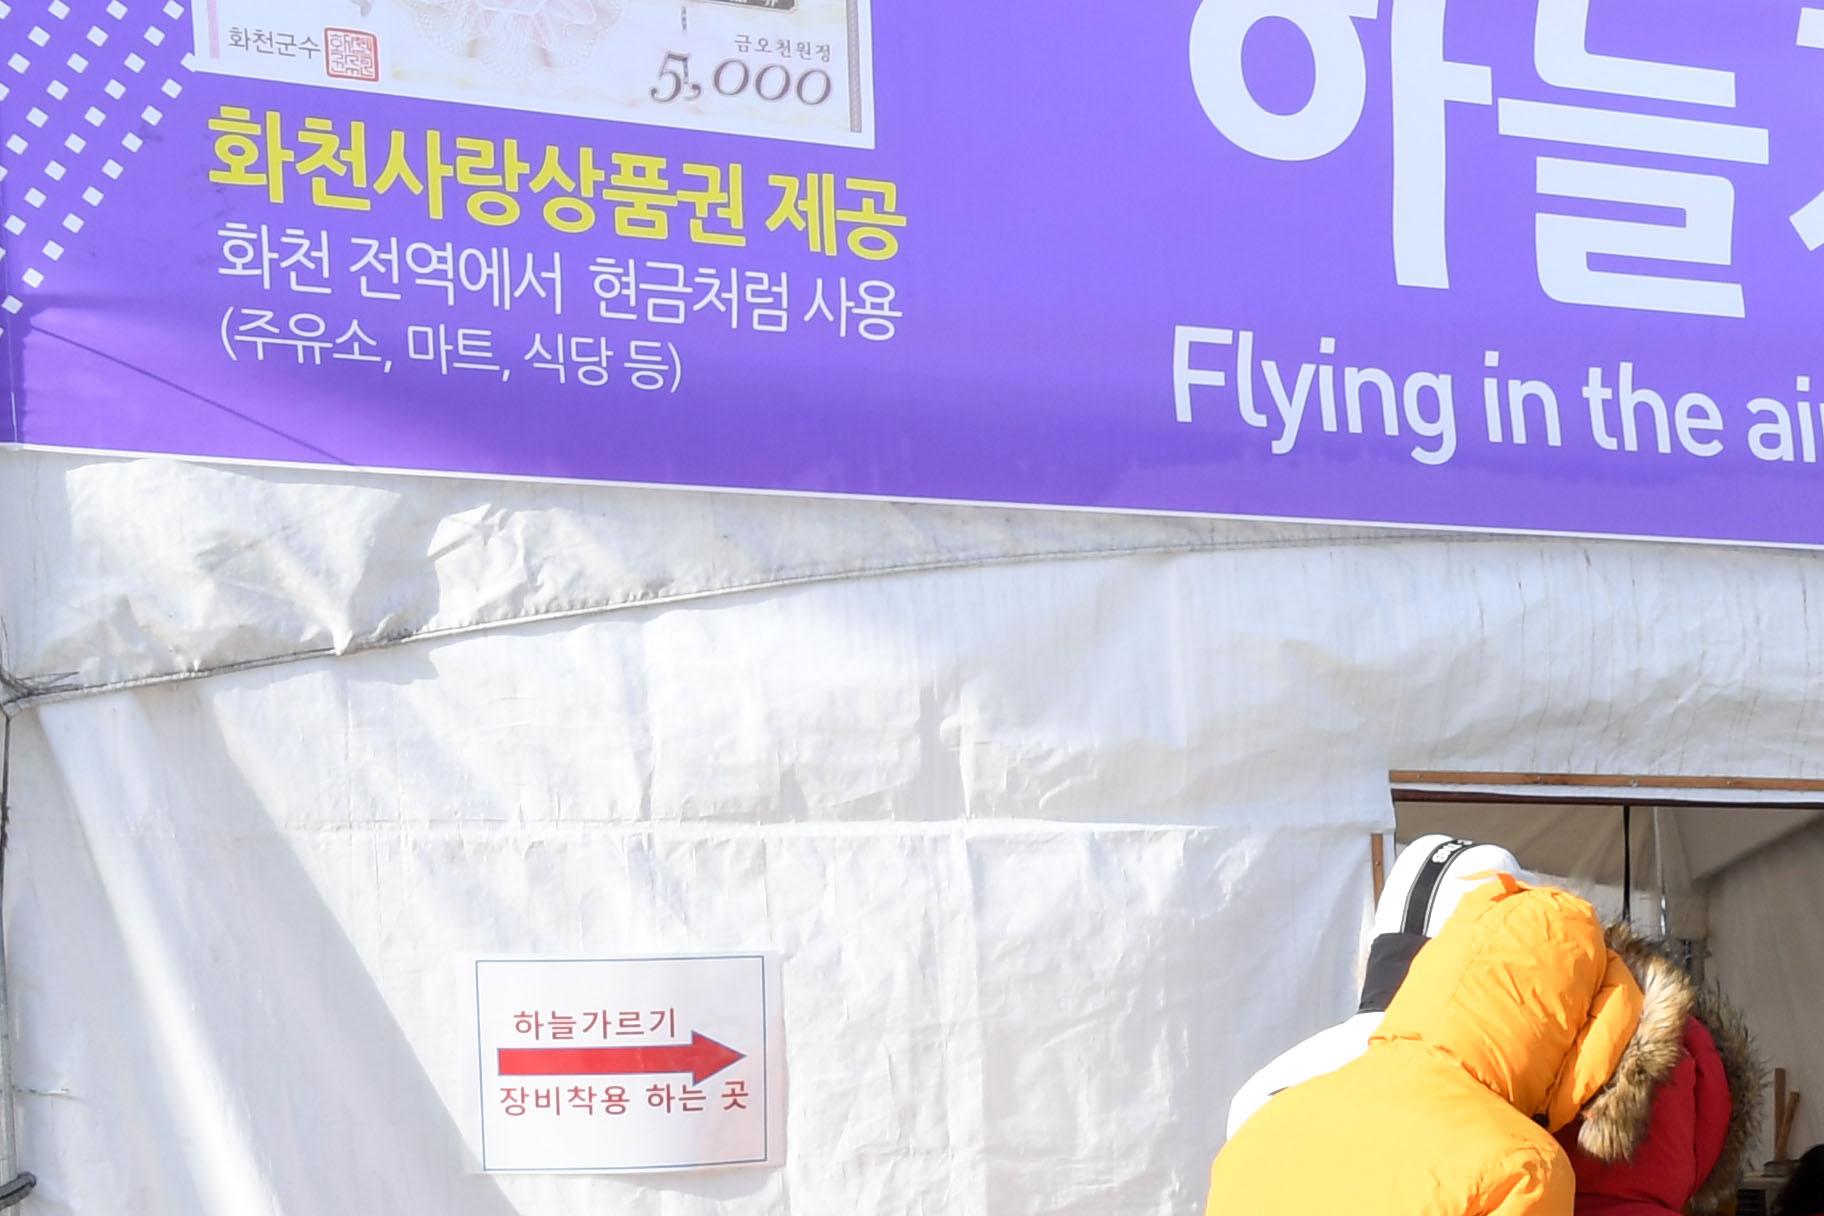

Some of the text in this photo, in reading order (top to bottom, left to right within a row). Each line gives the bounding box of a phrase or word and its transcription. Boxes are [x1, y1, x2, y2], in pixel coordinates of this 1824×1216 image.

[228, 26, 321, 59] 화천군수
[734, 34, 831, 63] 금오천원정
[650, 50, 832, 106] 5,000
[207, 105, 908, 261] 화천사랑상품권 제공
[217, 222, 904, 341] 화천 전역에서 현금처럼 사용
[219, 306, 682, 393] (주유소, 마트, 식당 등)
[1173, 324, 1457, 465] Flying
[1484, 350, 1562, 447] in
[1582, 361, 1724, 457] the
[513, 1007, 676, 1041] 하늘가르기
[499, 1080, 750, 1117] 장비착용 하는 곳
